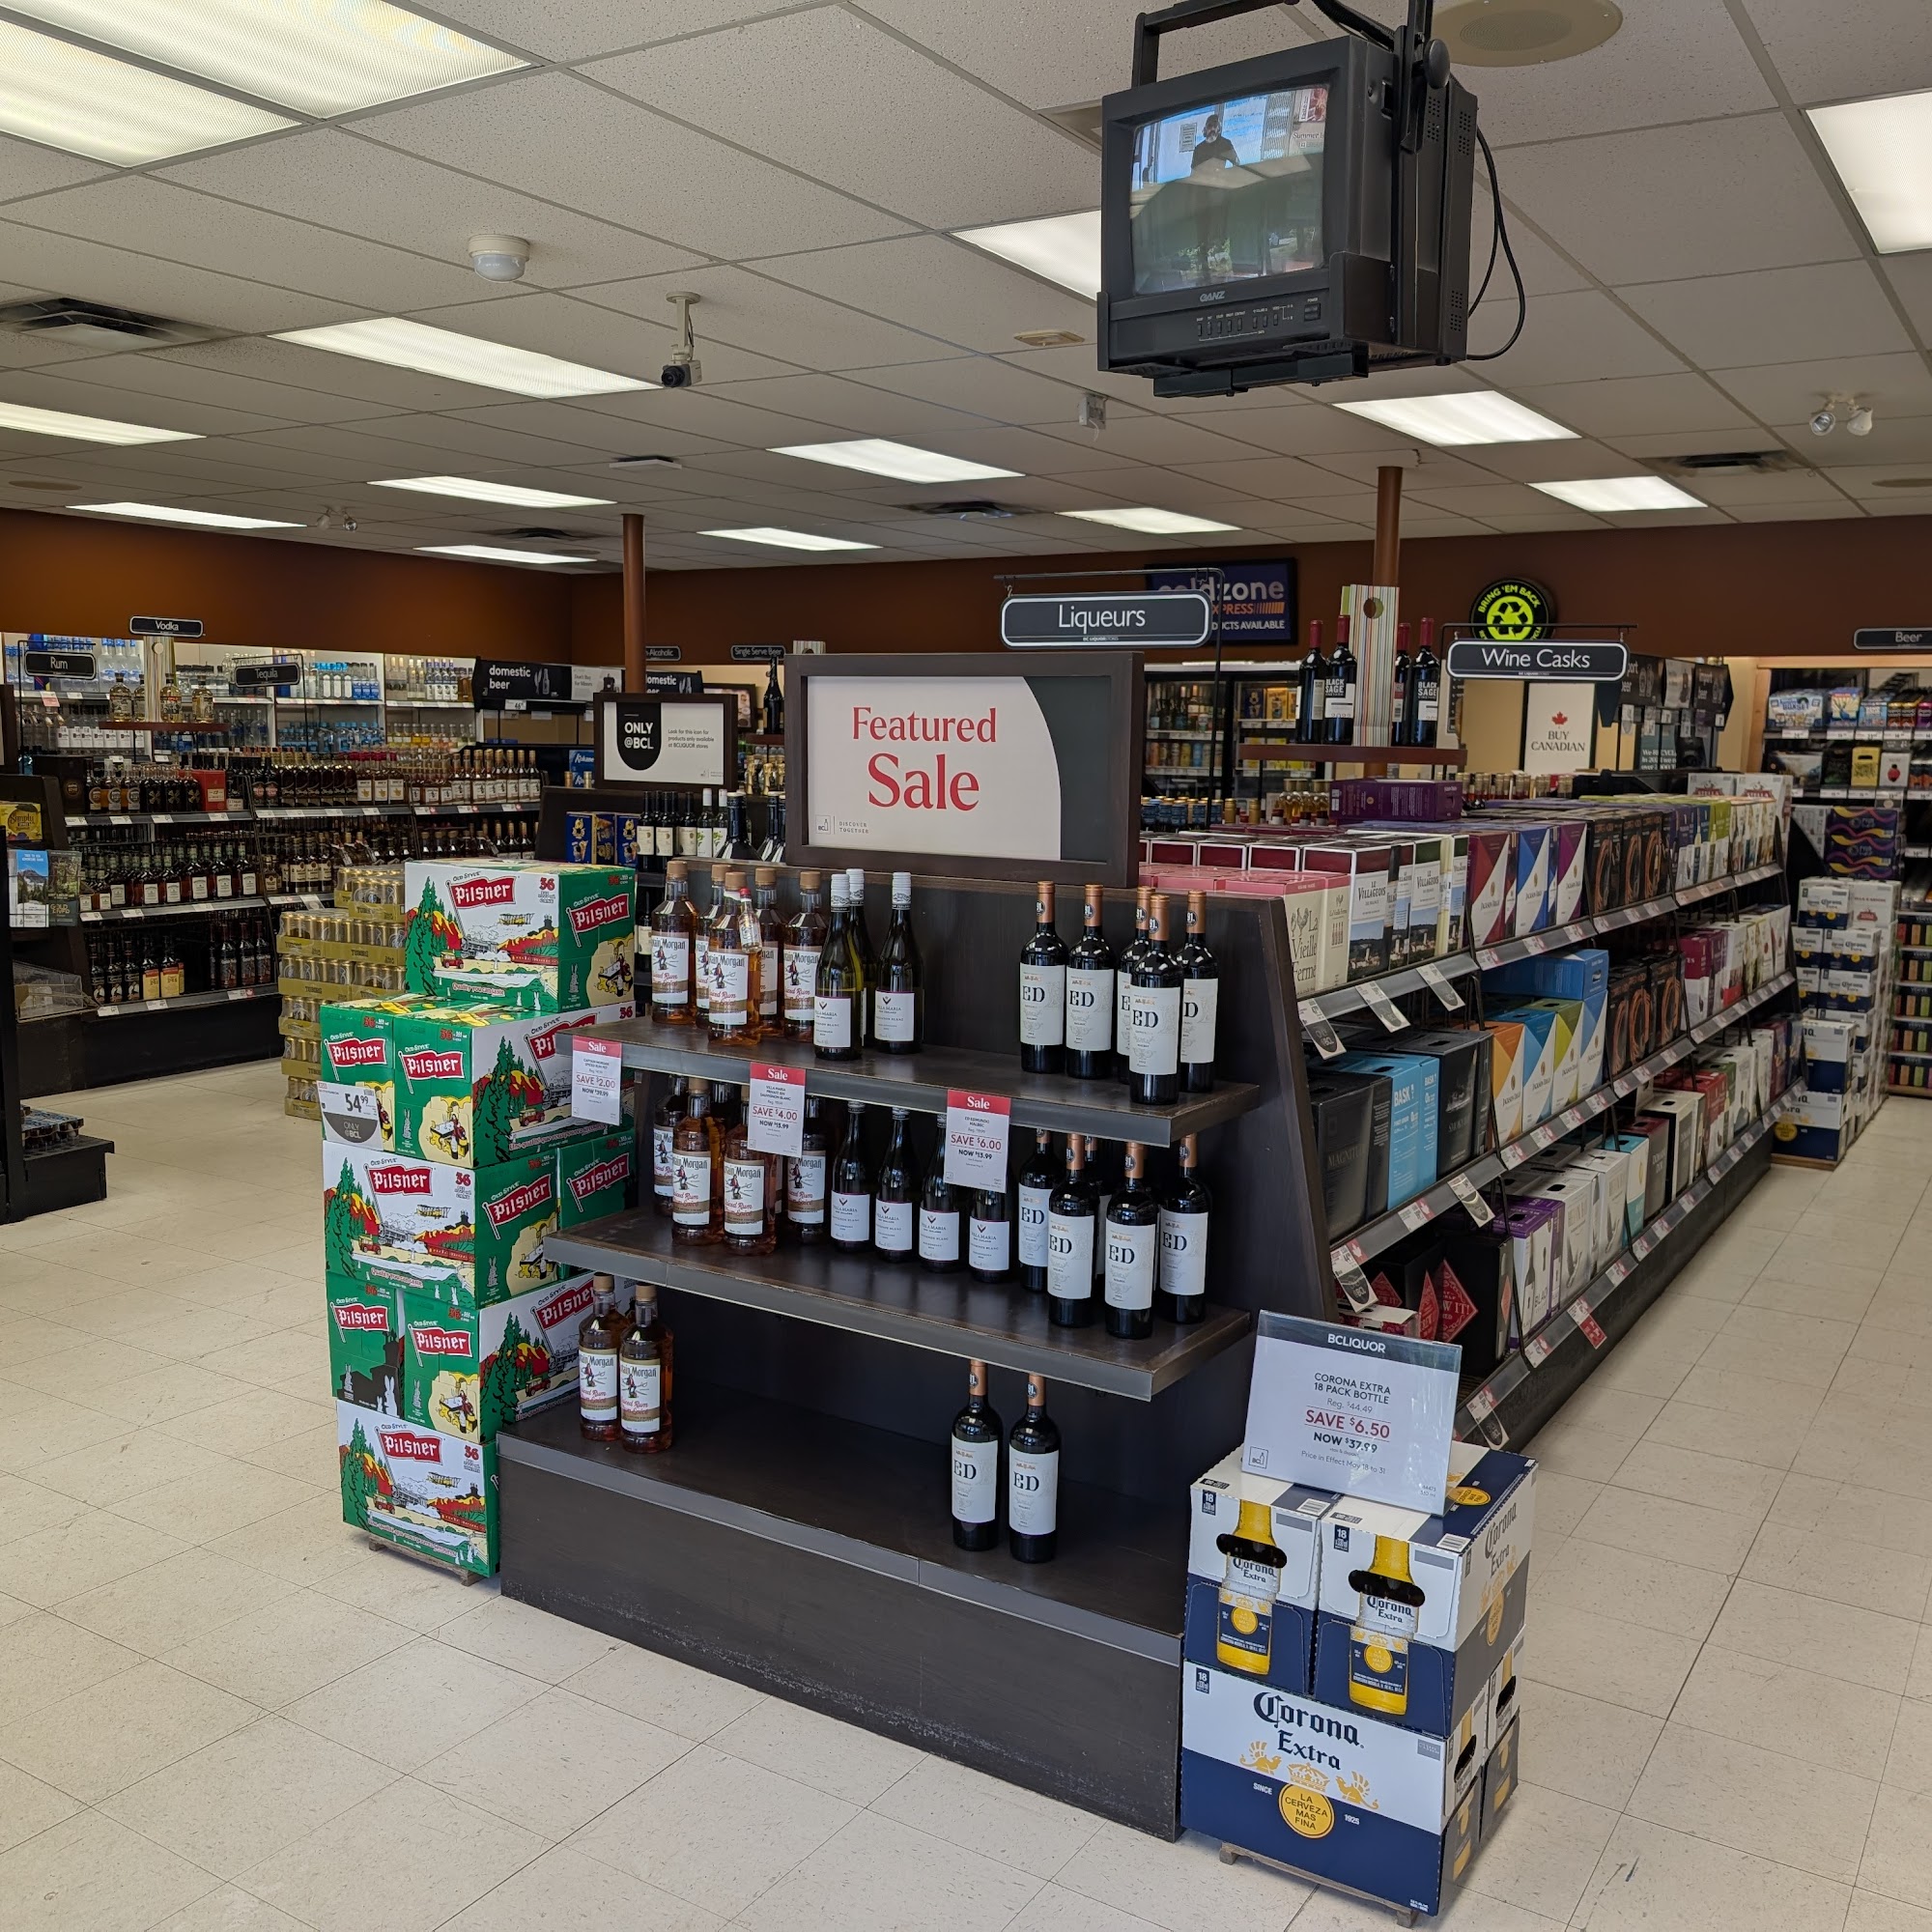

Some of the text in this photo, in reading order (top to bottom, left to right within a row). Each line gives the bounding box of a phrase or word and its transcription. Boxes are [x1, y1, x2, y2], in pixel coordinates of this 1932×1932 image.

[1200, 291, 1226, 302] GANZ
[1477, 584, 1541, 613] BRING 'EM BACK
[156, 620, 180, 631] Vodka
[1059, 604, 1146, 635] Liqueurs
[1239, 620, 1285, 630] AVAILABLE
[1894, 632, 1922, 643] Beer
[50, 657, 69, 669] Rum
[1482, 648, 1591, 668] Wine Casks
[254, 668, 279, 680] Tequila
[489, 665, 531, 677] domestic
[489, 679, 510, 691] beer
[1325, 685, 1344, 694] SAGE
[624, 722, 653, 734] ONLY
[852, 707, 997, 743] Featured
[1548, 731, 1570, 741] BUY
[624, 737, 654, 750] @BCL
[1531, 742, 1585, 752] CANADIAN
[867, 753, 980, 810] Sale
[10, 813, 35, 825] Simply
[467, 870, 481, 880] STYLE
[539, 877, 555, 891] 36
[1417, 876, 1439, 889] VILLAGEOIS
[454, 883, 511, 904] Pilsner
[583, 893, 599, 903] STYLE
[1358, 887, 1386, 901] VILLAGEOIS
[576, 900, 626, 927] Pilsner
[1308, 911, 1318, 932] La
[662, 938, 686, 951] Morgan
[1292, 938, 1317, 959] Vieille
[351, 949, 369, 957] TUBORG
[720, 954, 745, 968] Morgan
[1069, 990, 1094, 1008] ED
[619, 1007, 633, 1019] 36
[1132, 1009, 1158, 1028] ED
[530, 1016, 561, 1035] OLD STYLE
[331, 1043, 382, 1061] Pilsner
[587, 1041, 607, 1054] Sale
[407, 1057, 458, 1075] Pilsner
[768, 1067, 788, 1081] Sale
[576, 1074, 616, 1089] SAVE $2.00
[967, 1095, 990, 1110] Sale
[753, 1106, 798, 1121] SAVE $4.00
[343, 1121, 359, 1130] ONLY
[345, 1129, 361, 1139] @BCL
[951, 1134, 1002, 1151] SAVE $6.00
[382, 1157, 398, 1166] STYLE
[958, 1149, 993, 1160] NOW $13.99
[682, 1158, 707, 1171] Morgan
[455, 1172, 471, 1187] 36
[736, 1166, 761, 1179] Morgan
[373, 1172, 428, 1190] Pilsner
[1021, 1207, 1045, 1225] ED
[1049, 1235, 1072, 1254] ED
[1162, 1232, 1187, 1251] ED
[1109, 1244, 1135, 1264] ED
[1454, 1303, 1470, 1315] IT!
[338, 1310, 384, 1326] Pilsner
[415, 1333, 467, 1352] Pilsner
[1327, 1333, 1386, 1353] BCLIQUOR
[589, 1355, 614, 1368] Morgan
[632, 1366, 657, 1378] Morgan
[1314, 1373, 1391, 1395] CORONA EXTRA
[1314, 1381, 1389, 1405] 18 PACK BOTTLE
[1326, 1398, 1373, 1414] Reg. $44.49
[1305, 1409, 1390, 1439] SAVE $6.50
[1313, 1432, 1378, 1454] NOW $37.99
[464, 1445, 479, 1461] 36
[1301, 1450, 1318, 1461] Price
[1325, 1456, 1345, 1465] Effect
[1346, 1461, 1361, 1471] May
[953, 1459, 978, 1480] ED
[1205, 1493, 1214, 1502] 18
[1337, 1528, 1348, 1539] 18
[1485, 1502, 1518, 1559] Corona
[1233, 1556, 1275, 1577] Corona
[1491, 1544, 1510, 1578] Extra
[1243, 1570, 1266, 1583] Extra
[1367, 1594, 1415, 1617] Corona
[1378, 1609, 1403, 1623] Extra
[1197, 1671, 1208, 1682] 18
[1253, 1691, 1364, 1749] Corona
[1277, 1729, 1342, 1771] Extra
[1253, 1781, 1273, 1796] SINCE
[1299, 1794, 1313, 1803] LA
[1284, 1797, 1328, 1817] CERVEZA
[1295, 1808, 1318, 1822] MAS
[1344, 1812, 1360, 1826] 1925
[1294, 1817, 1317, 1831] FINA
